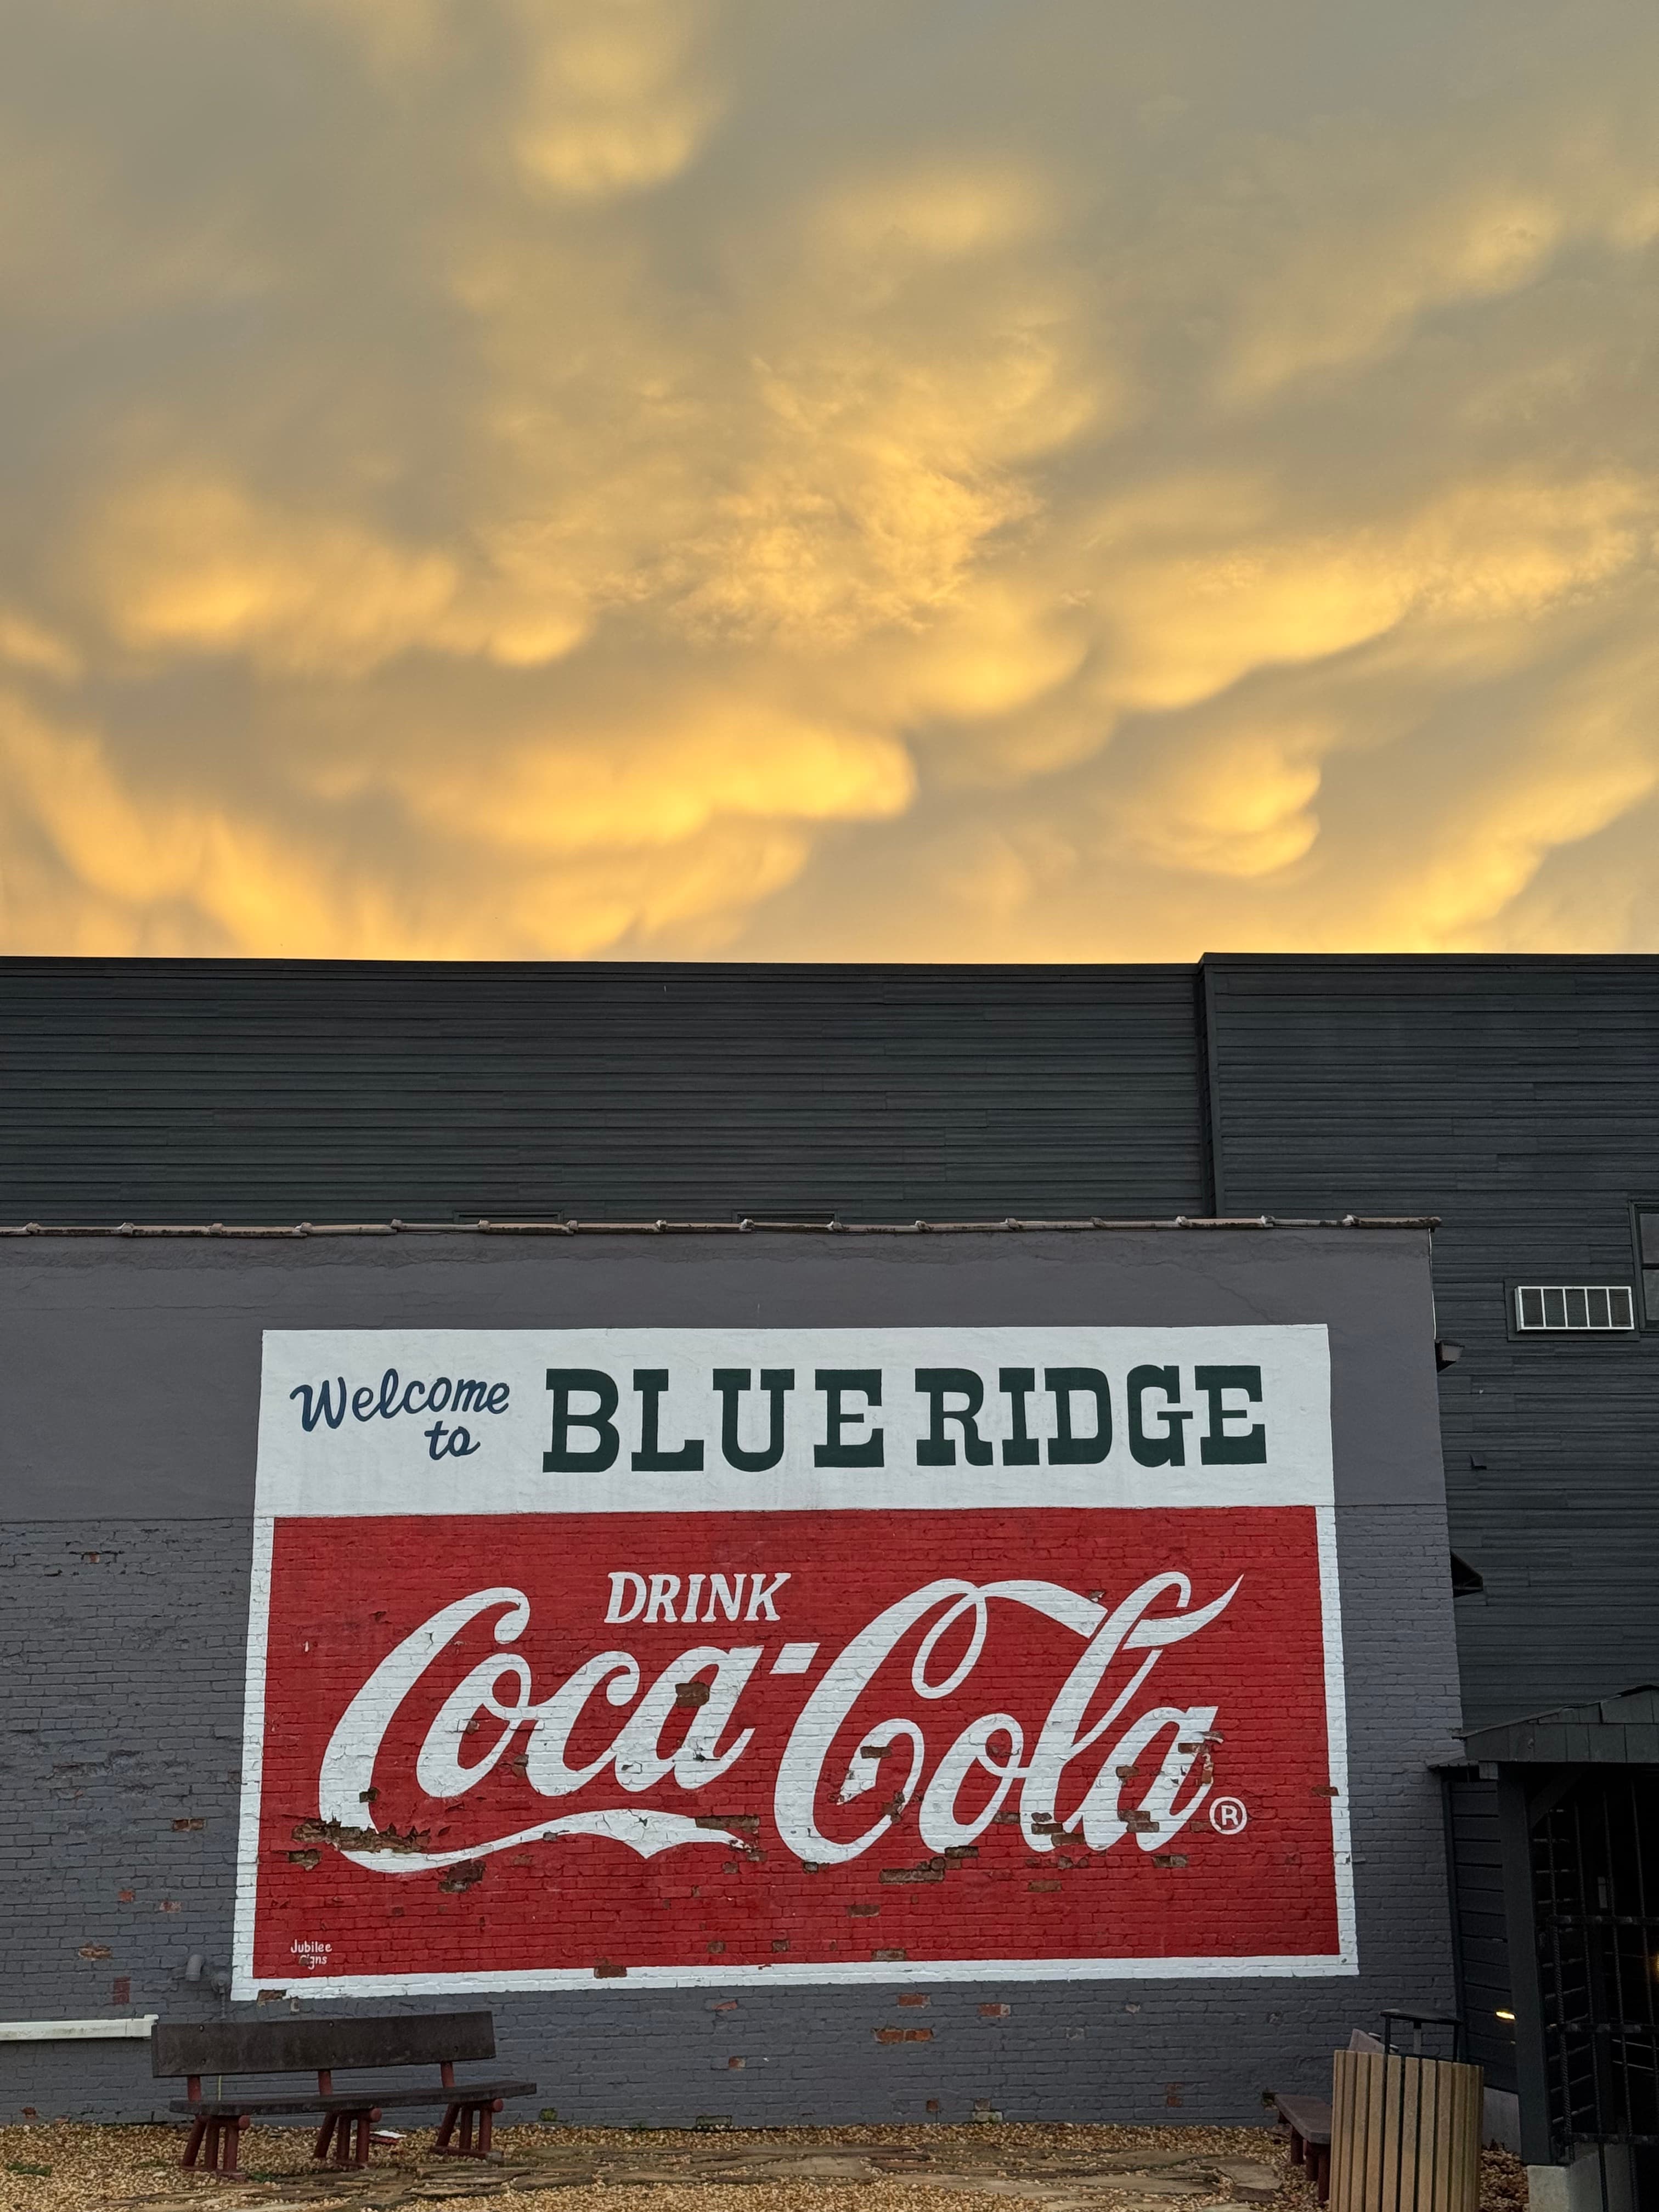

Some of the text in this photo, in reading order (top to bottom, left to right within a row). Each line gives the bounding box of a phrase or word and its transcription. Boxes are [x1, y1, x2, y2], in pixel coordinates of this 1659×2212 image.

[290, 1368, 510, 1432] Welcome
[543, 1364, 1267, 1472] BLUE RIDGE
[424, 1420, 481, 1460] to
[604, 1572, 791, 1624] DRINK
[290, 1939, 332, 1954] Jubilee
